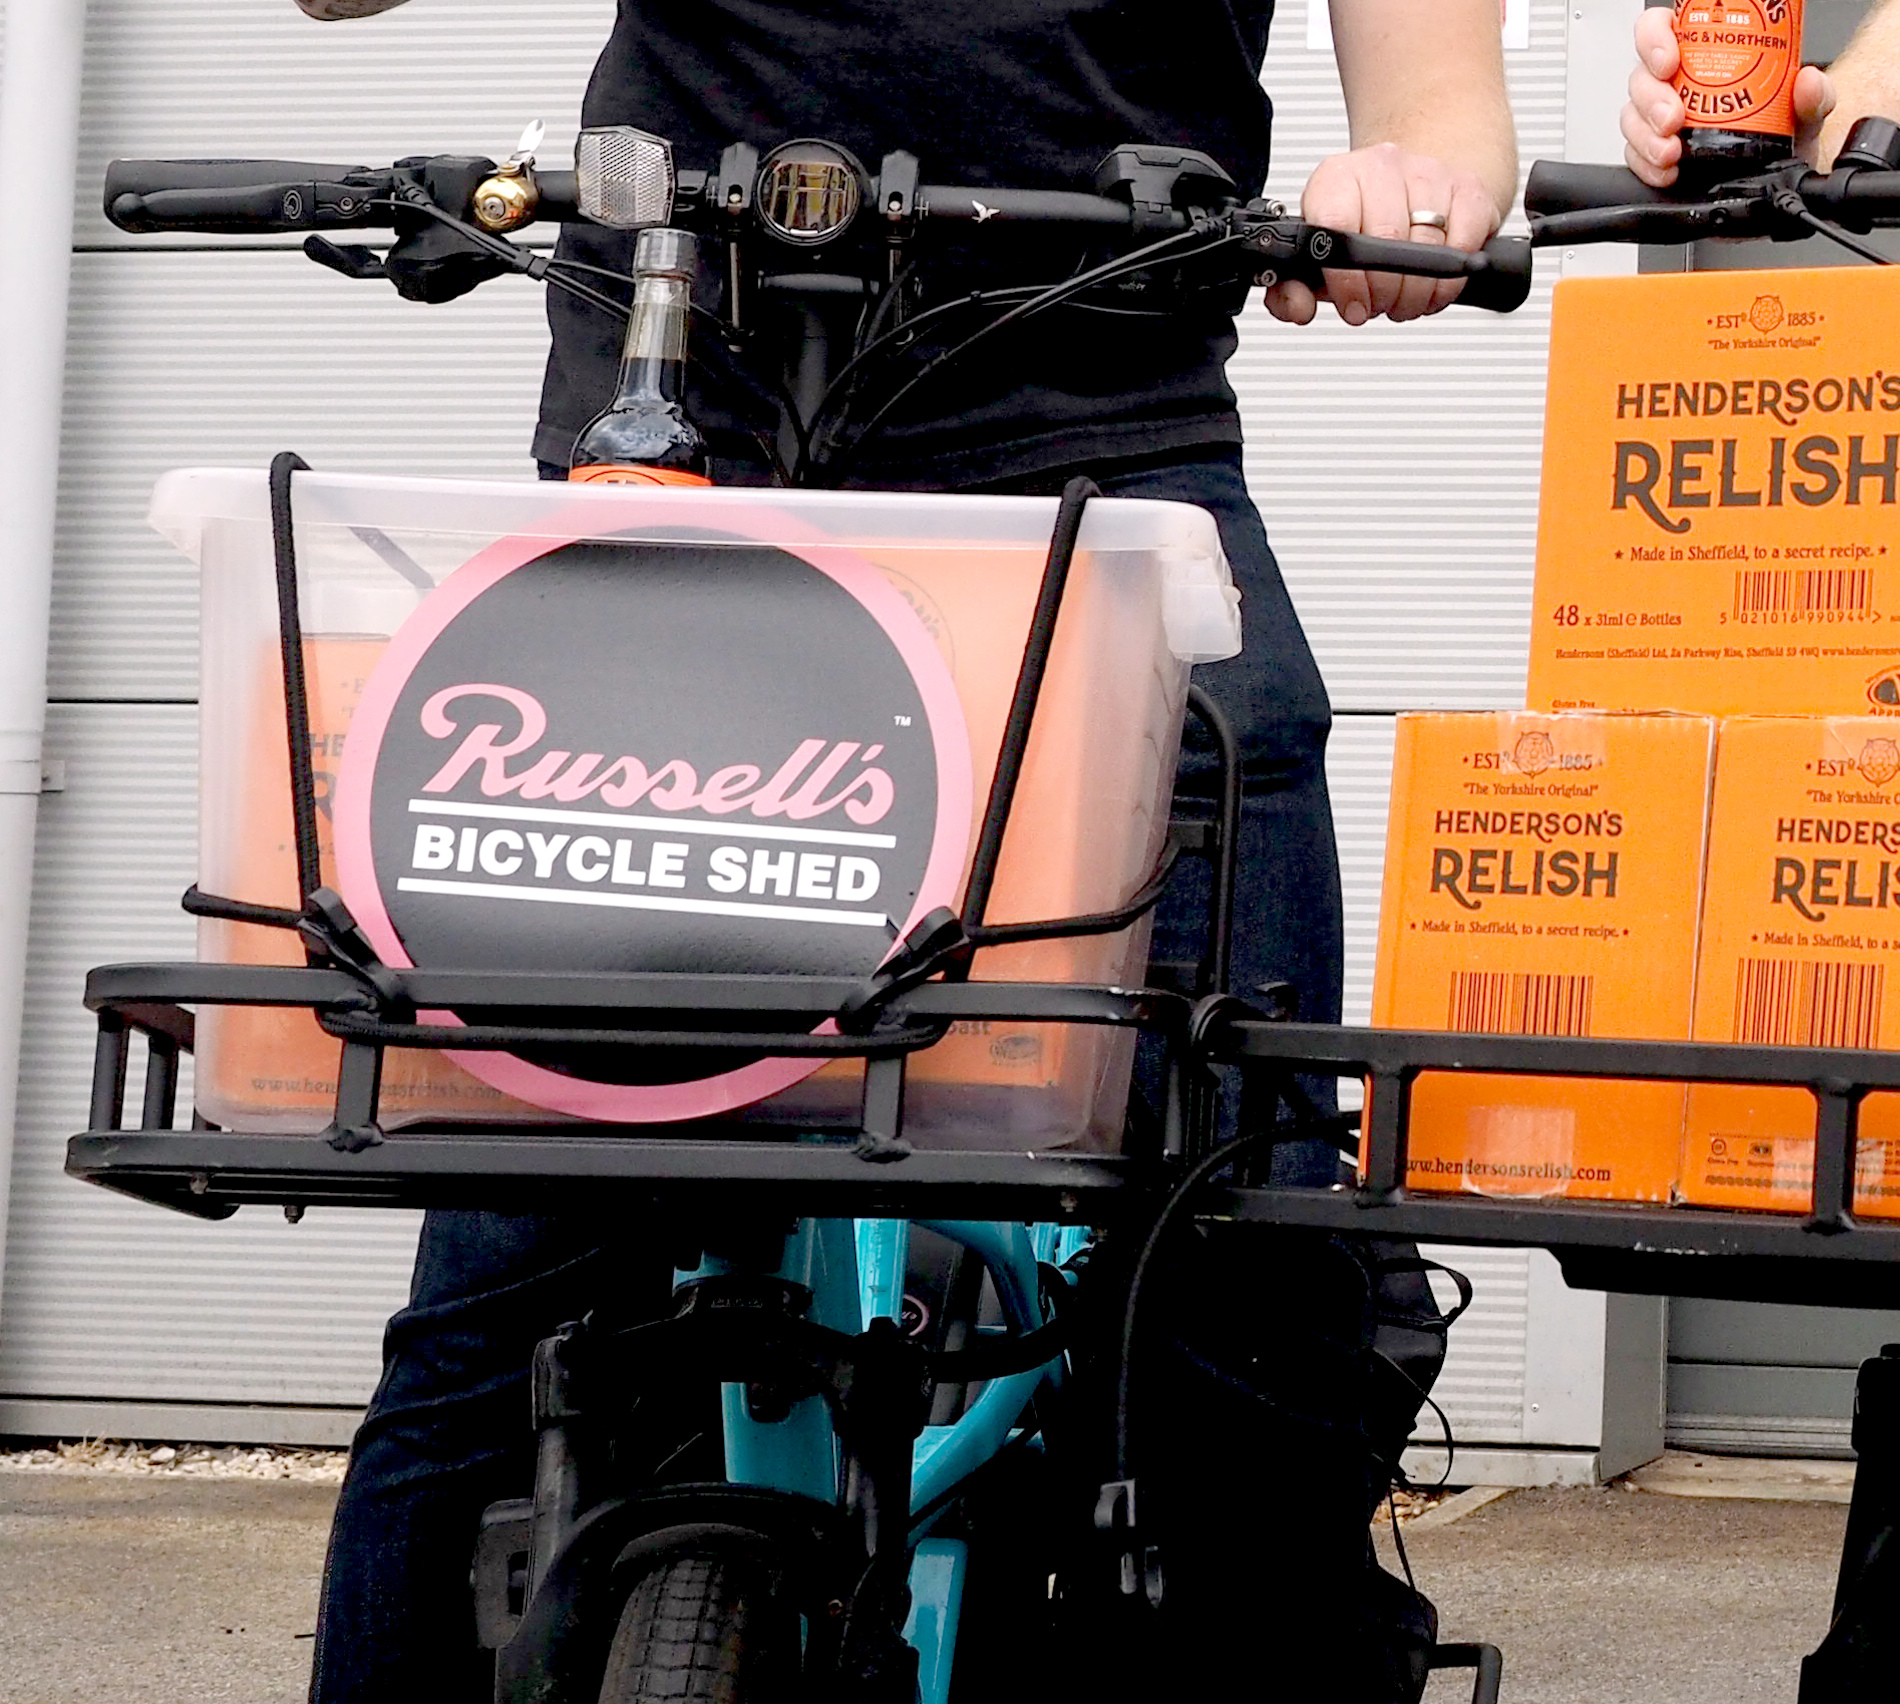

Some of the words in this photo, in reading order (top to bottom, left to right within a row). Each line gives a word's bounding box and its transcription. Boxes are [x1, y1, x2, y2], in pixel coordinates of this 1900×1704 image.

[1701, 31, 1710, 43] &
[1713, 31, 1788, 50] NORTHERN
[1787, 311, 1816, 327] 1885
[1610, 434, 1900, 534] RELISH
[1630, 547, 1665, 561] Made
[1670, 546, 1683, 560] in
[1687, 544, 1749, 562] Sheffield,
[1754, 546, 1767, 559] to
[1772, 549, 1780, 559] a
[1784, 545, 1825, 559] secret
[1829, 543, 1875, 561] recipe.
[1553, 604, 1579, 627] 48
[1583, 616, 1592, 626] x
[1639, 613, 1682, 626] Bottles
[1719, 612, 1727, 625] 5
[1684, 648, 1720, 660] Parkway
[420, 683, 894, 825] Russell's
[894, 715, 912, 727] TM
[1493, 783, 1546, 796] Yorkshire
[1836, 790, 1891, 805] Yorkshire
[1434, 809, 1623, 843] HENDERSON'S
[412, 824, 689, 889] BICYCLE
[706, 846, 881, 902] SHED
[1430, 847, 1619, 910] RELISH
[1421, 920, 1451, 933] Made
[1454, 920, 1465, 933] in
[1468, 920, 1518, 936] Sheffield,
[1522, 923, 1533, 935] to
[1536, 926, 1543, 935] a
[1546, 925, 1579, 936] secret
[1583, 924, 1620, 941] recipe.
[1764, 932, 1794, 945] Made
[1797, 932, 1808, 946] in
[1812, 934, 1863, 950] Sheffield,
[1867, 936, 1878, 949] to
[1882, 940, 1888, 949] a
[1406, 1157, 1611, 1181] ww.hendersonsrelish.com
